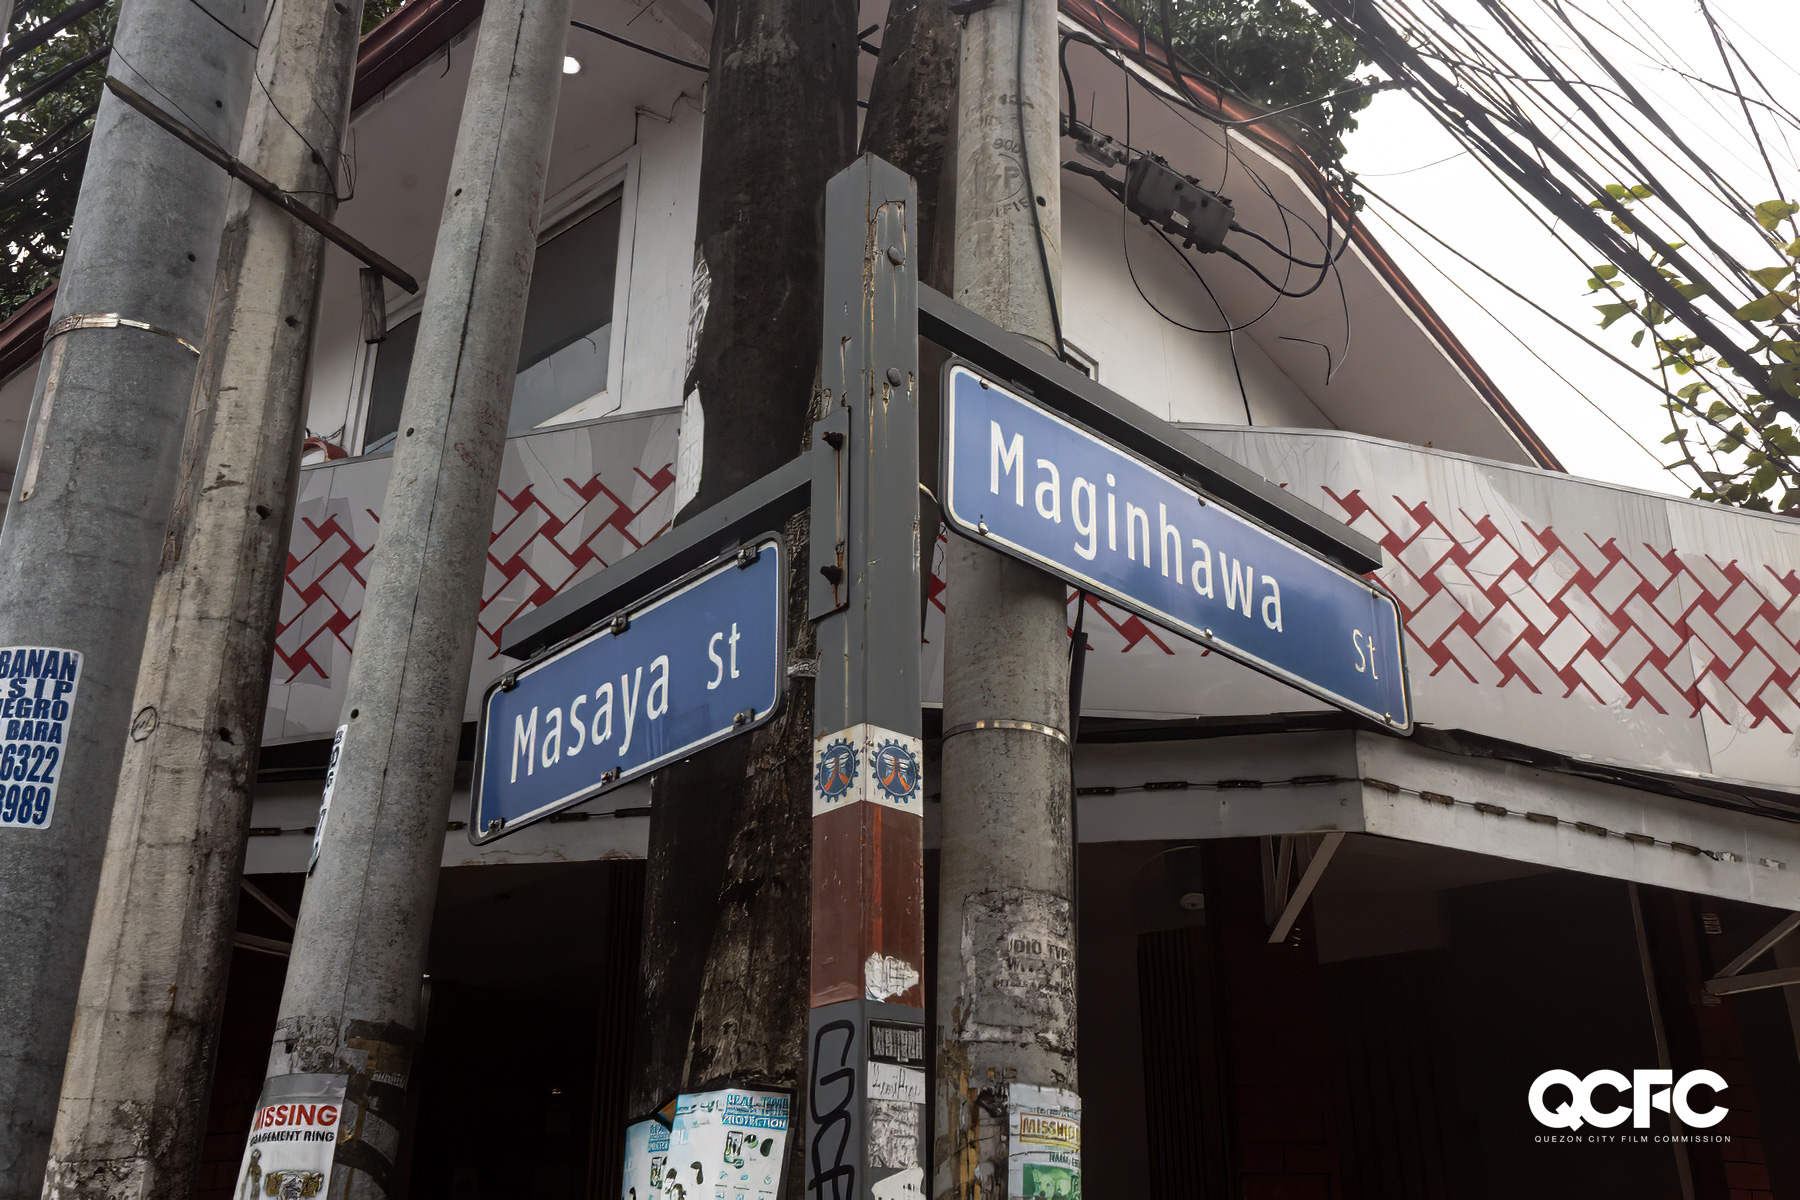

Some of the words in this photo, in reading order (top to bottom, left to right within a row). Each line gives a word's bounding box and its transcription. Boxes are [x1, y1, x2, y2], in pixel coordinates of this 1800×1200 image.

[989, 419, 1284, 633] Maginhawa
[1352, 628, 1379, 681] St
[5, 719, 62, 744] BARA
[510, 654, 670, 784] Masaya
[706, 622, 741, 690] St
[303, 1130, 335, 1142] RING
